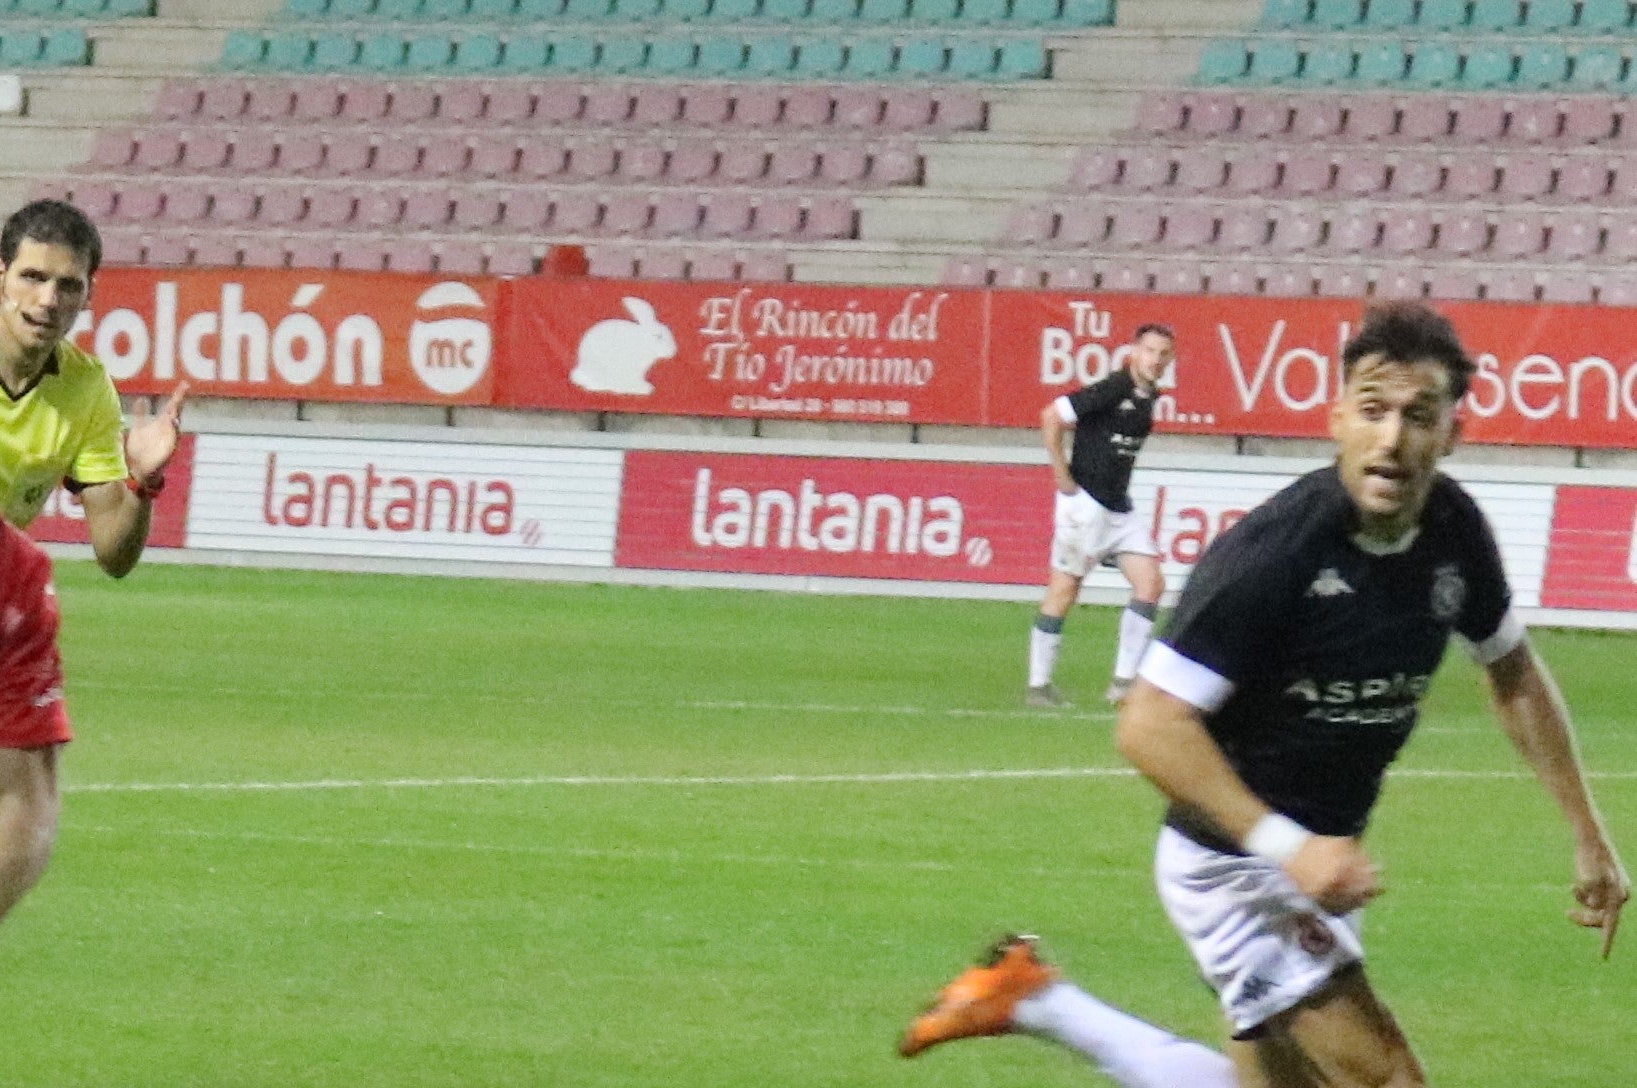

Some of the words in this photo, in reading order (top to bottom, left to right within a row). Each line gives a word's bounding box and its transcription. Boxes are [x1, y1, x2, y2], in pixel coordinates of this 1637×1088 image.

[699, 288, 752, 338] El
[754, 298, 878, 340] Rincón
[887, 292, 949, 341] del
[1068, 301, 1111, 338] Tu
[426, 338, 474, 369] mc
[769, 344, 934, 394] Jerónimo
[265, 451, 514, 537] lantania
[691, 467, 963, 558] lantania
